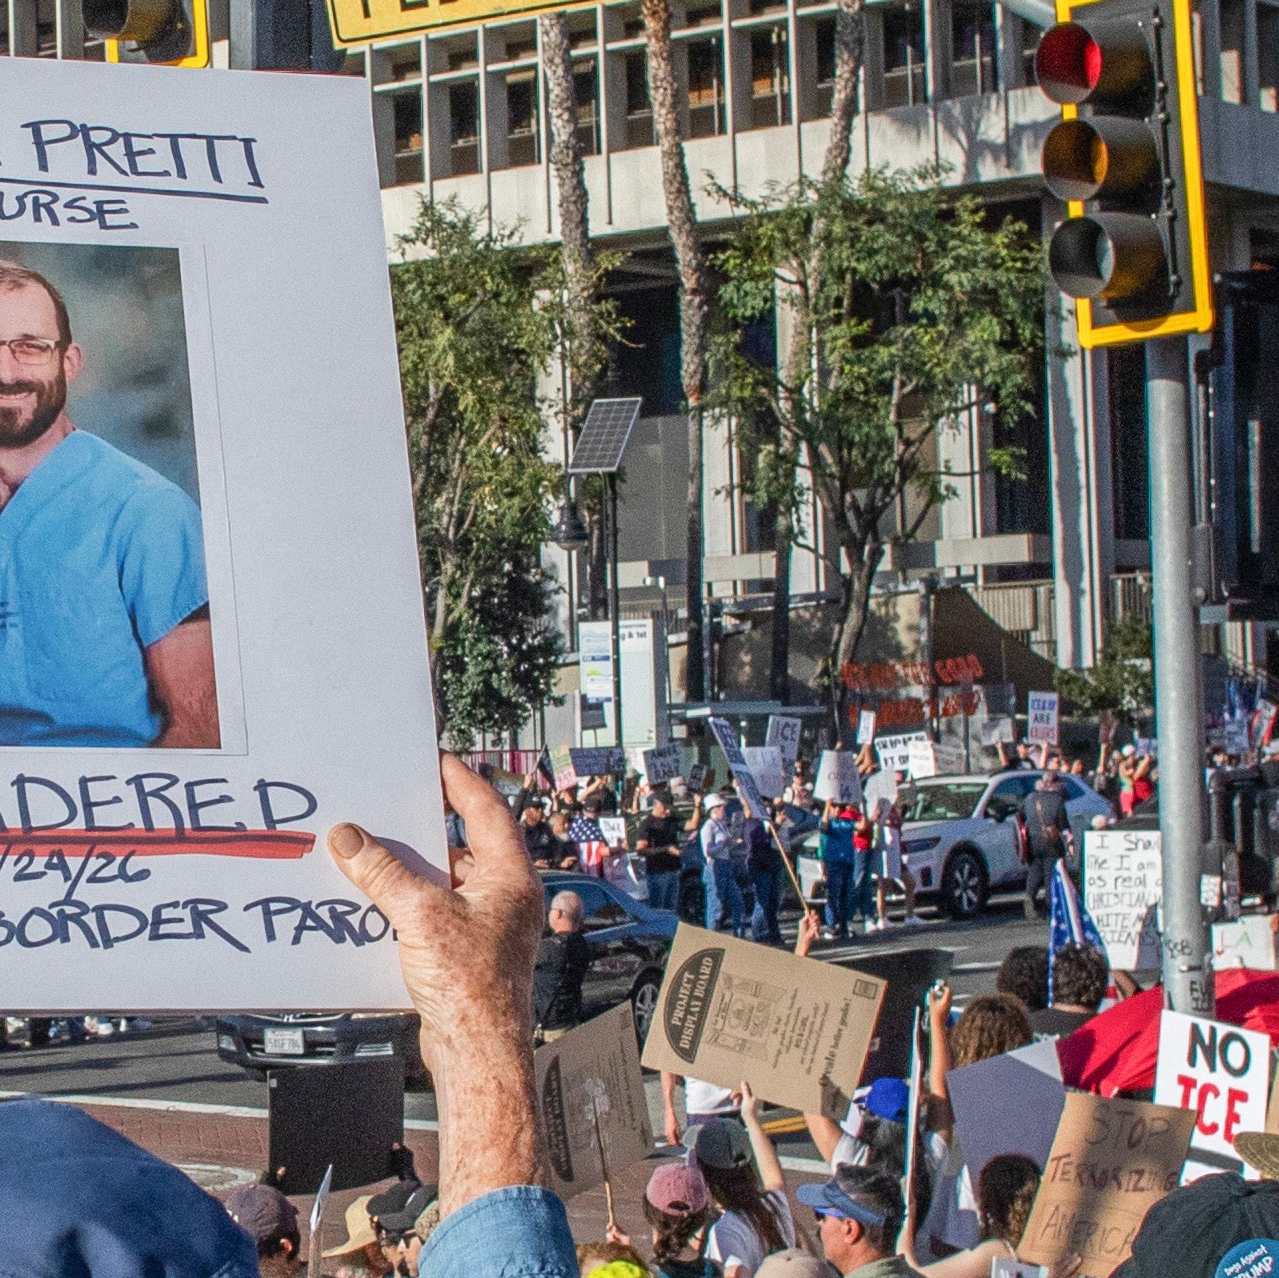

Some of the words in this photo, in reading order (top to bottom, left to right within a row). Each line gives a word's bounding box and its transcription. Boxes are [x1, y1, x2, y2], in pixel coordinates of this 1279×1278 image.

[20, 119, 266, 188] PRETTI
[1096, 834, 1109, 850] I
[1115, 854, 1131, 872] I
[1114, 875, 1147, 890] real
[242, 896, 399, 948] PARO
[671, 971, 695, 1026] PROJECT
[679, 1000, 702, 1050] DISPLAY
[696, 957, 713, 1000] BOARD
[1186, 1021, 1252, 1079] NO
[1084, 1102, 1173, 1151] STOP
[1176, 1073, 1249, 1145] ICE
[1224, 1262, 1242, 1277] Dogs
[1240, 1244, 1269, 1266] Against
